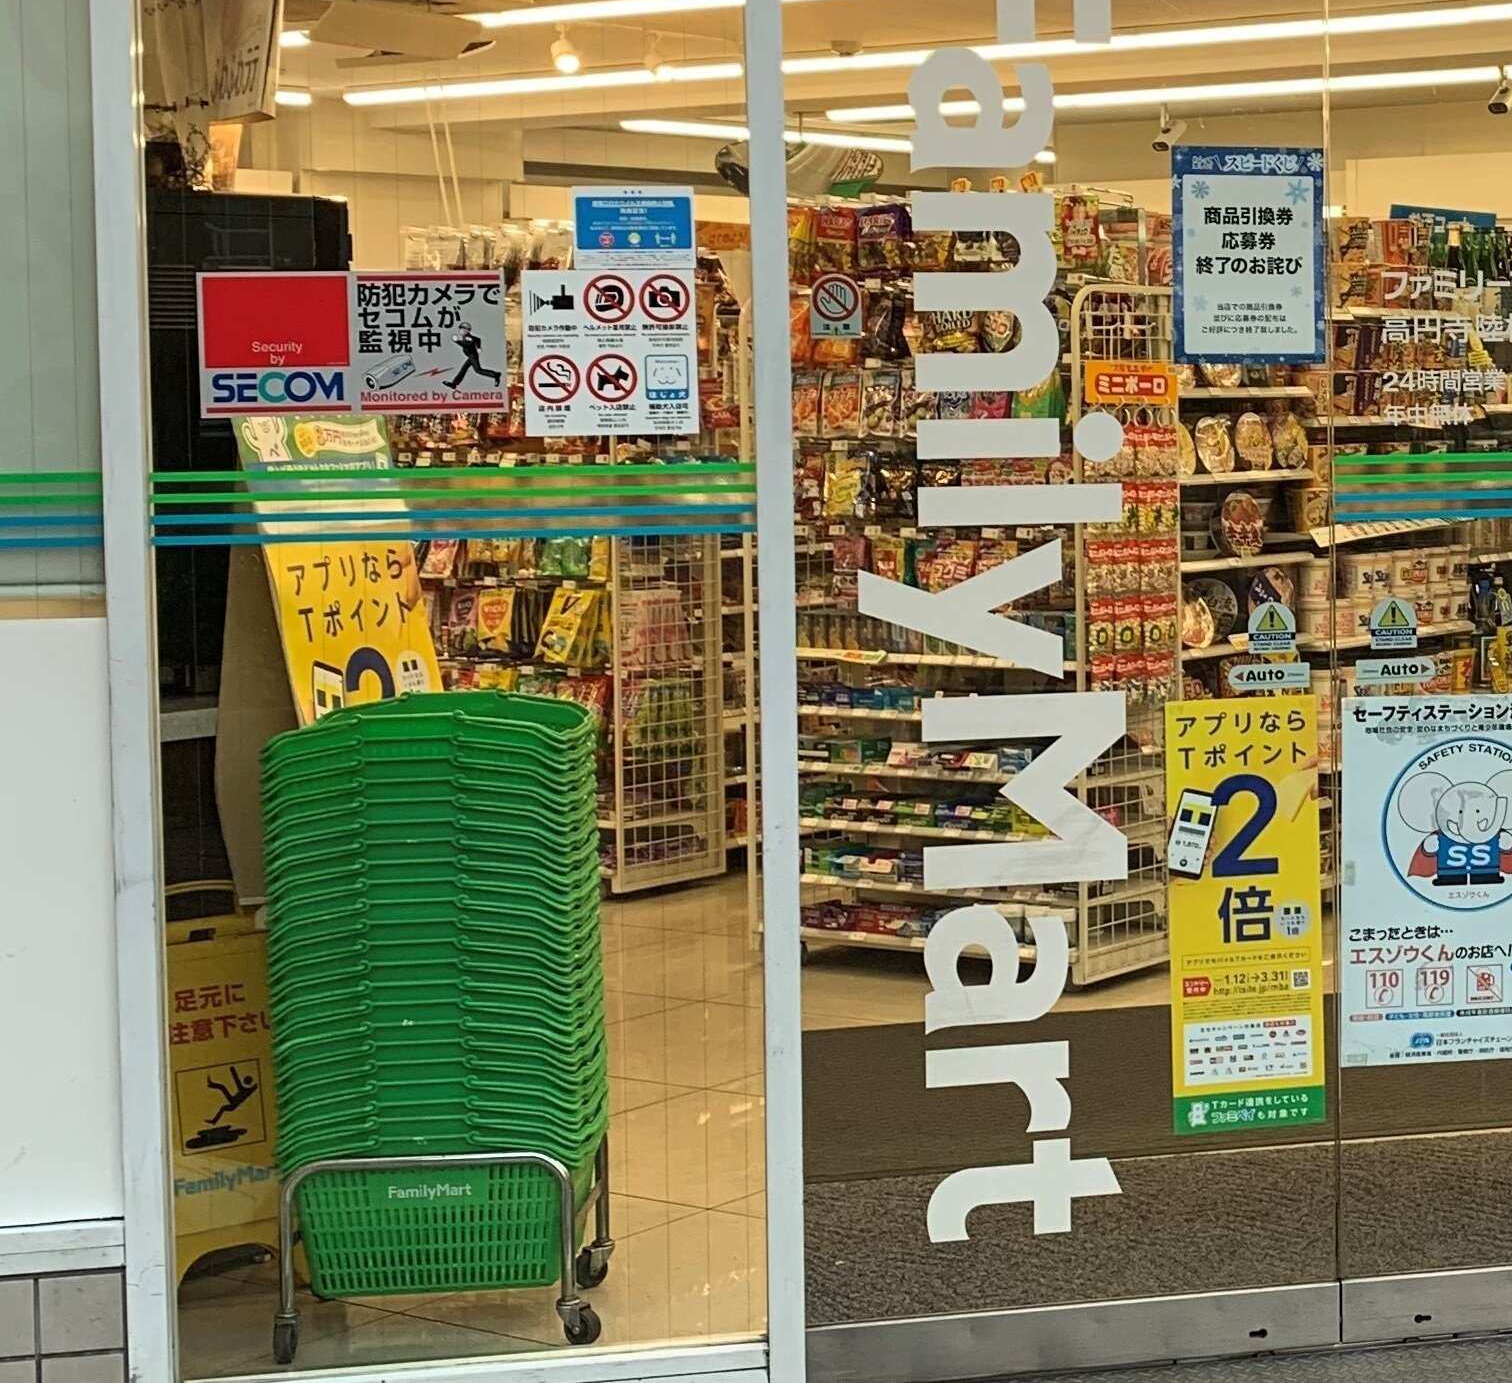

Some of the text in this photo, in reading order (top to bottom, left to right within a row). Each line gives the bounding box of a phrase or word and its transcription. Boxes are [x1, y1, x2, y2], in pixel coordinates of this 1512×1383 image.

[1203, 206, 1294, 226] 商品引換券
[1221, 231, 1276, 250] 応募券
[1195, 256, 1303, 275] 終了のお詫び
[356, 283, 500, 307] 防犯カメラで
[358, 306, 460, 330] セコムが
[252, 341, 302, 354] Security
[358, 329, 441, 353] 監視中
[270, 353, 285, 366] by
[212, 371, 344, 403] SECOM
[1382, 368, 1507, 392] 24時間営業
[361, 389, 503, 403] Monitored by Camera
[287, 549, 404, 596] アプリなら
[298, 592, 413, 643] Tポイント
[1253, 633, 1292, 641] CAUTION
[1375, 628, 1413, 636] CAUTION
[1245, 669, 1285, 682] Auto
[1380, 664, 1419, 676] Auto
[1175, 710, 1306, 737] アプリなら
[1178, 742, 1306, 769] Tポイント
[1418, 744, 1463, 770] SAFETY
[1211, 774, 1279, 878] 2
[1218, 885, 1274, 944] 倍
[1369, 971, 1400, 988] 110
[1420, 970, 1450, 987] 119
[174, 983, 246, 1013] 足元に
[388, 1183, 471, 1199] FamilyMart
